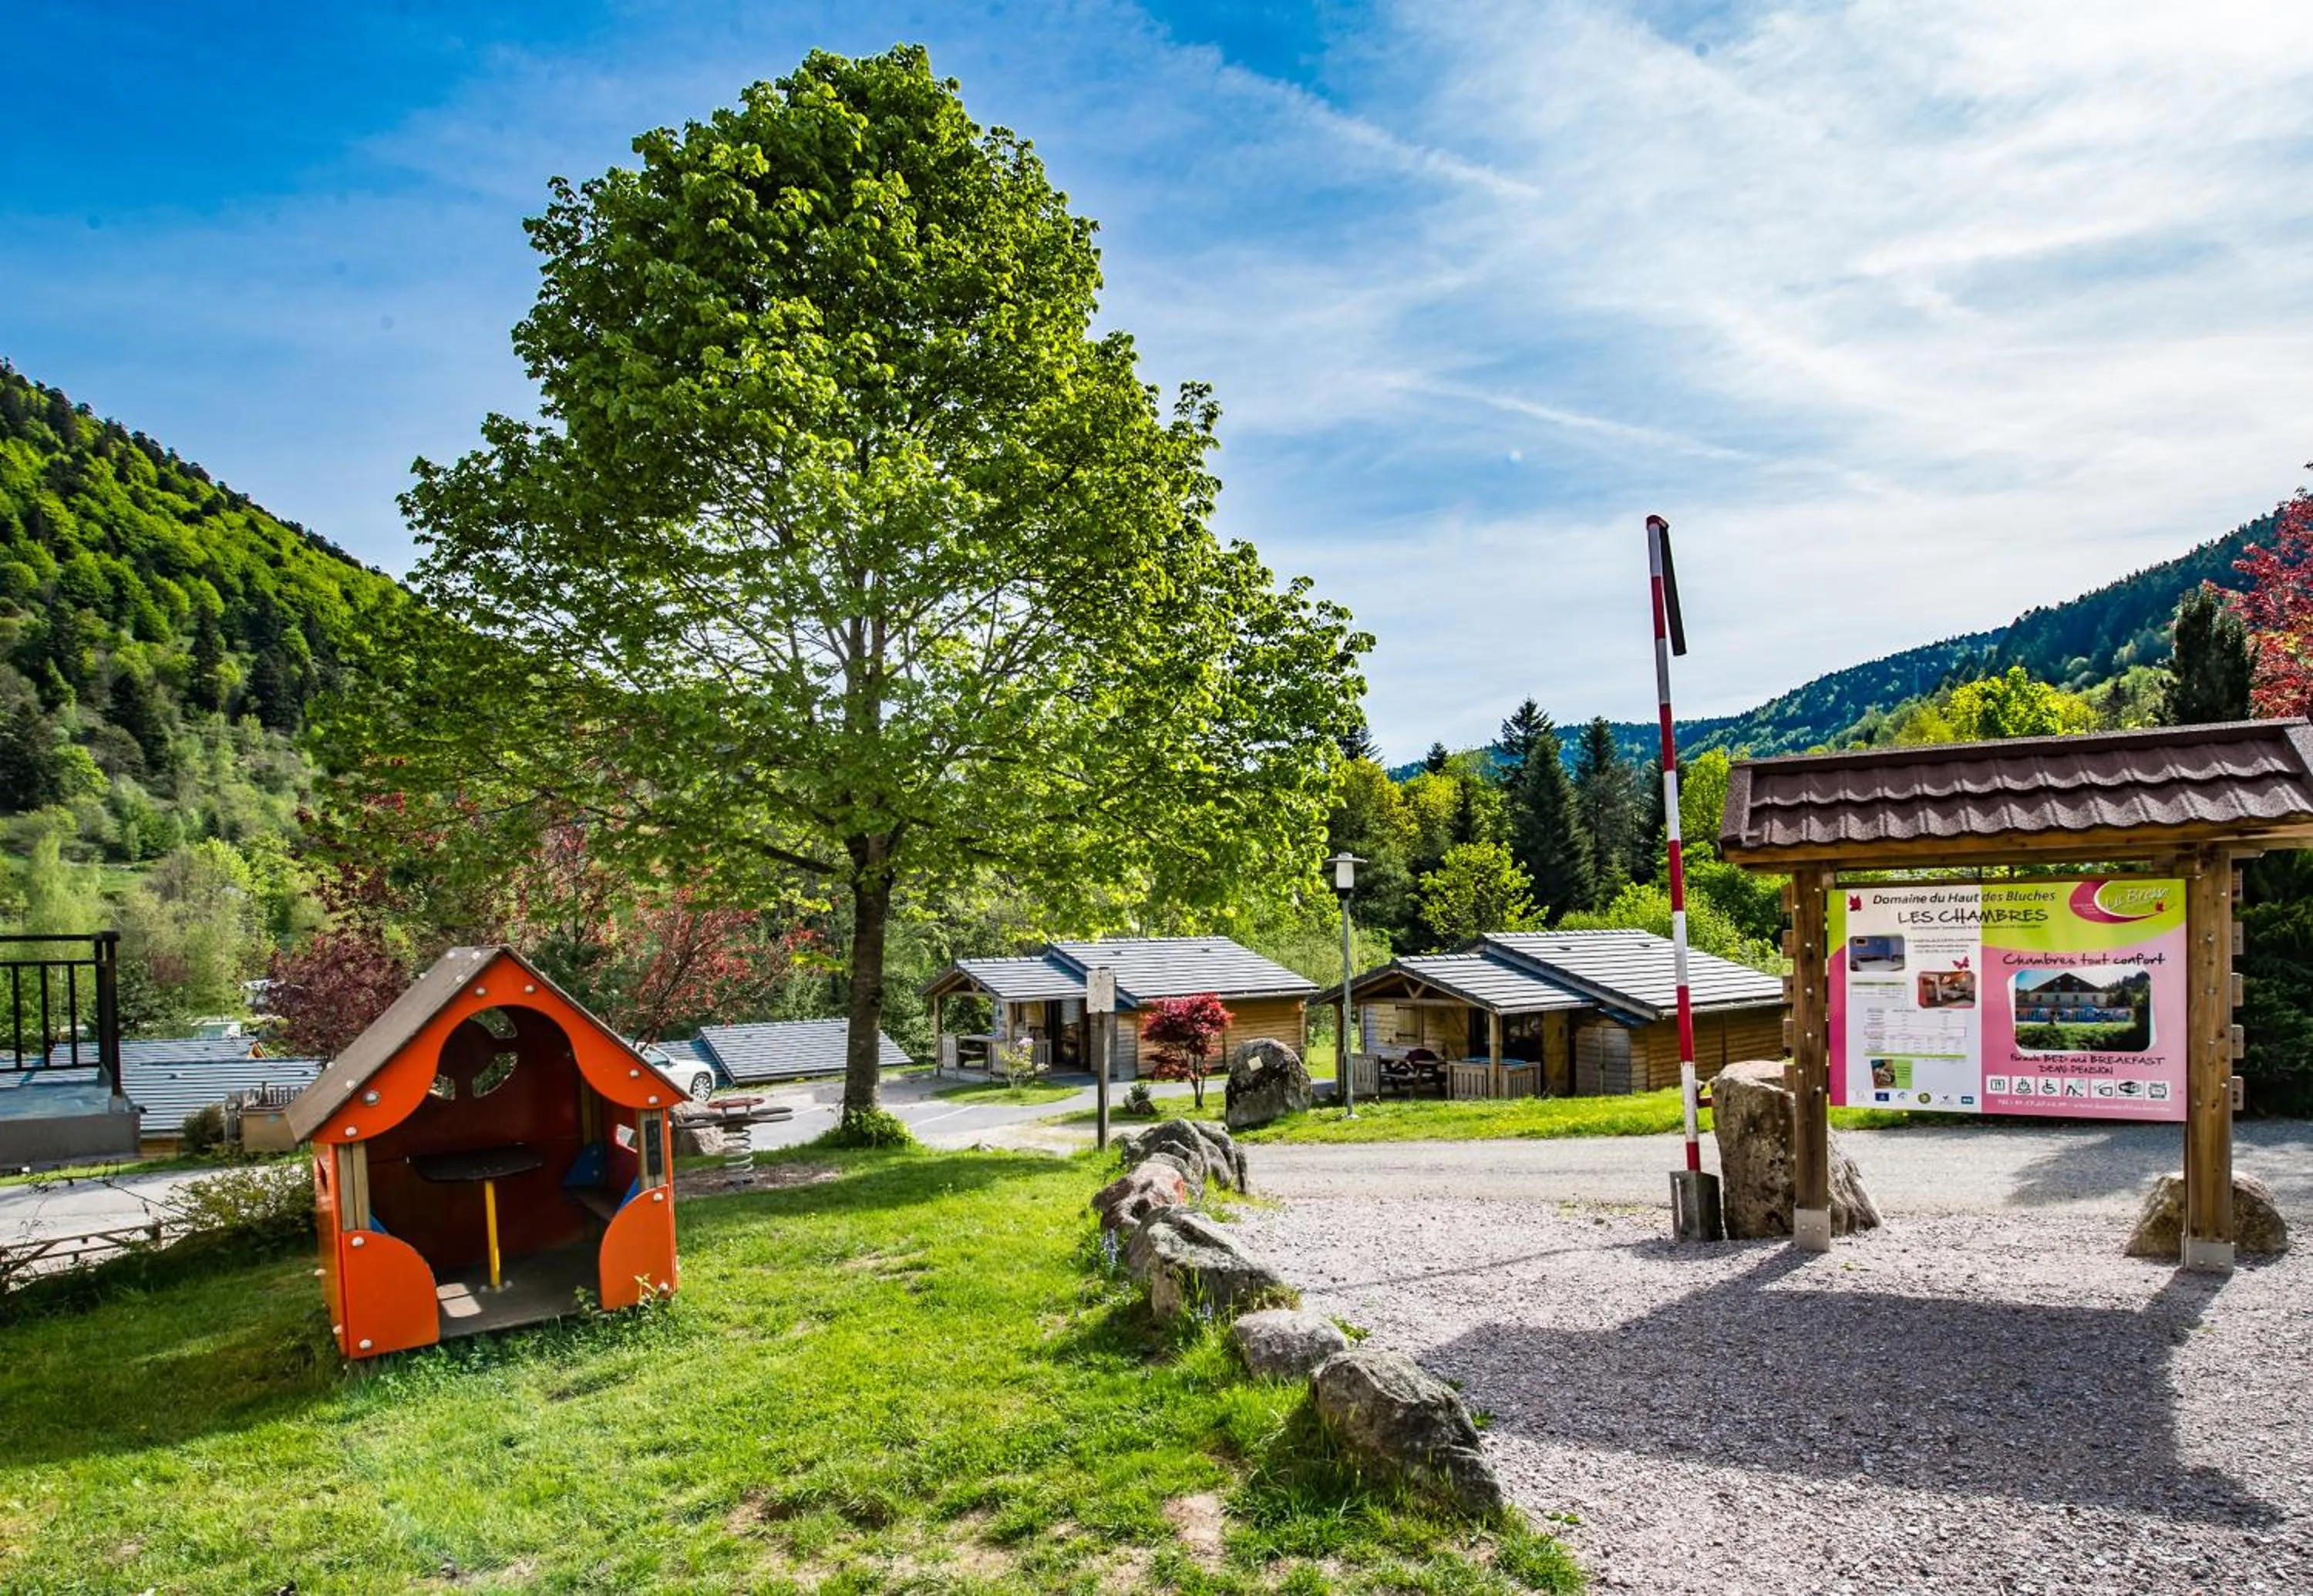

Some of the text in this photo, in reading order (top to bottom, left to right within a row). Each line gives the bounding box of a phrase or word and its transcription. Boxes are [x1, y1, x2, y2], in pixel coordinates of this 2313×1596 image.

[1873, 891, 2055, 904] Domaine du Haut des Bluches
[1897, 907, 2049, 924] LES CHAMBRES
[2002, 953, 2166, 965] Chambres tout confort
[2090, 1056, 2165, 1066] BREAKFAST
